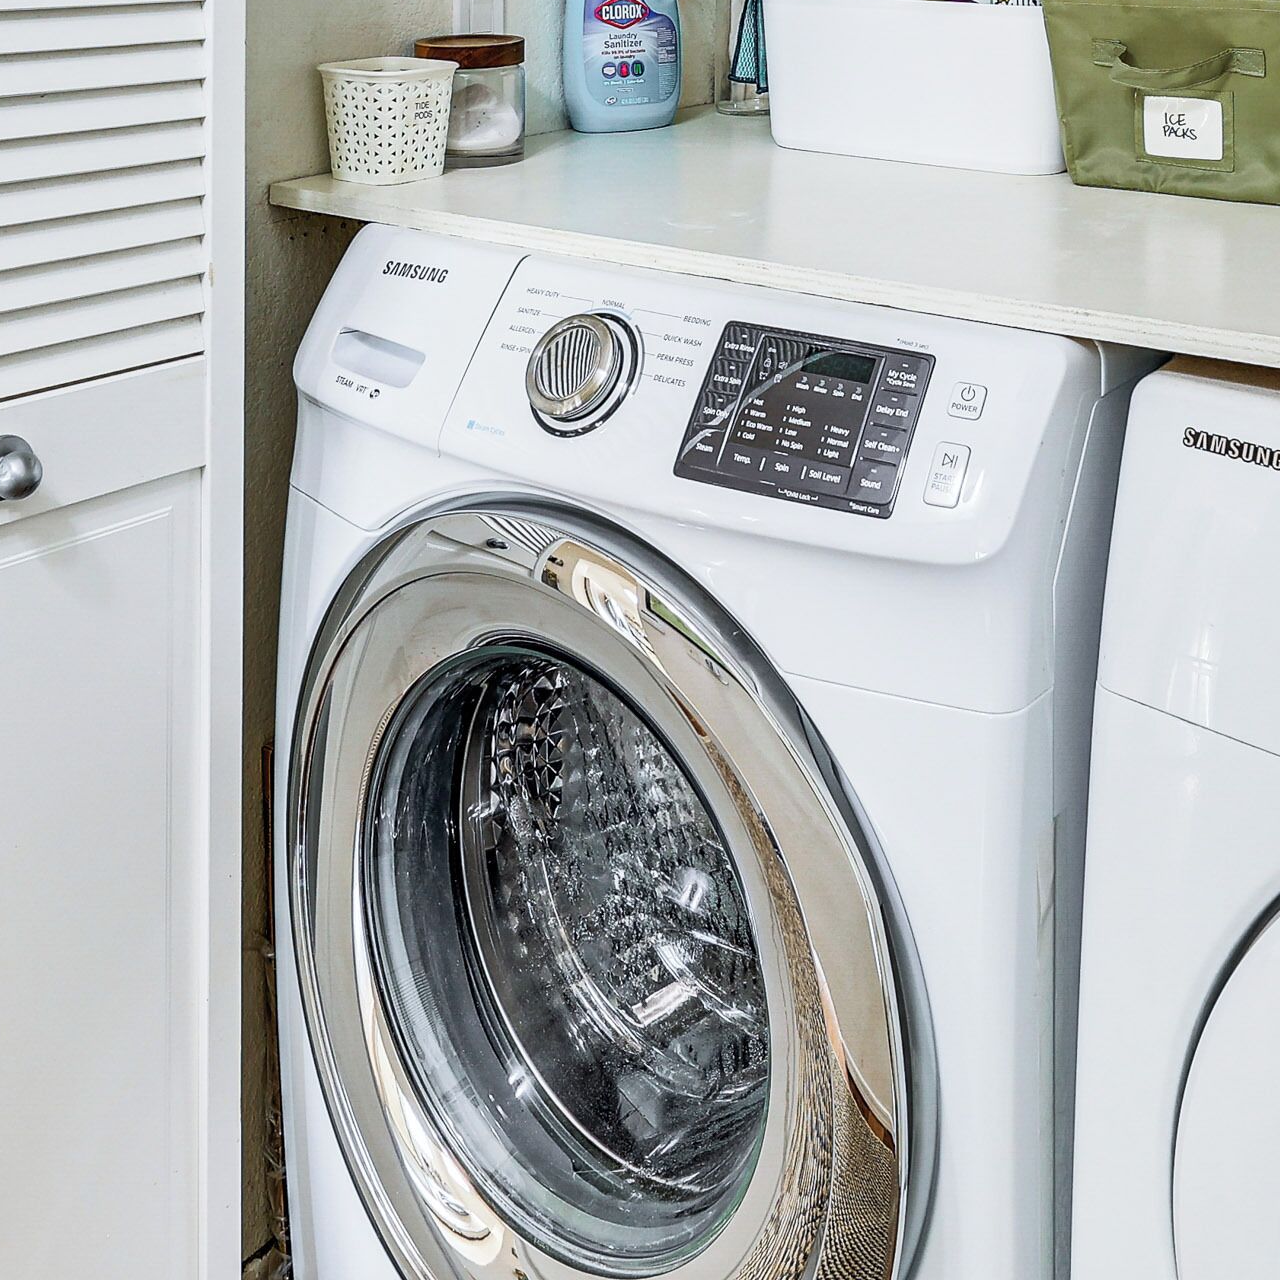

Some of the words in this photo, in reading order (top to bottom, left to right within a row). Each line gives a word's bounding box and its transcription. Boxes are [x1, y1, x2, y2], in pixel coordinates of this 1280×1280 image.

[601, 4, 642, 20] CLOROX
[609, 32, 638, 41] Laundry
[604, 40, 643, 49] Sanitizer
[415, 101, 430, 110] TIDE
[414, 110, 433, 120] PODS
[1164, 112, 1186, 126] ICE
[1163, 124, 1198, 141] PACKS
[382, 260, 449, 283] SAMSUNG
[526, 287, 545, 297] HEAVY
[545, 290, 560, 299] DUTY
[601, 299, 625, 310] NORMAL
[517, 306, 541, 317] SANITIZE
[683, 315, 712, 326] BEDDING
[509, 324, 536, 335] ALLERGEN
[663, 334, 683, 343] QUICK
[684, 337, 703, 347] WASH
[724, 341, 739, 350] Extra
[656, 352, 674, 363] PERM
[675, 356, 694, 367] PRESS
[653, 374, 686, 387] DELICATES
[713, 374, 729, 384] Extra
[729, 376, 742, 387] Spin
[888, 369, 899, 379] My
[900, 371, 917, 382] Cycle
[335, 375, 354, 388] STEAM
[703, 406, 716, 416] Spin
[792, 405, 807, 414] High
[876, 405, 895, 417] Delay
[896, 408, 910, 418] End
[951, 402, 978, 413] POWER
[788, 416, 812, 427] Medium
[830, 425, 850, 436] Heavy
[695, 442, 714, 453] Steam
[781, 439, 791, 447] No
[791, 441, 803, 451] Spin
[827, 437, 849, 448] Normal
[864, 439, 878, 449] Self
[823, 448, 840, 459] Light
[774, 462, 790, 473] Spin
[809, 469, 821, 479] Soil
[822, 471, 841, 483] Level
[860, 478, 882, 490] Sound
